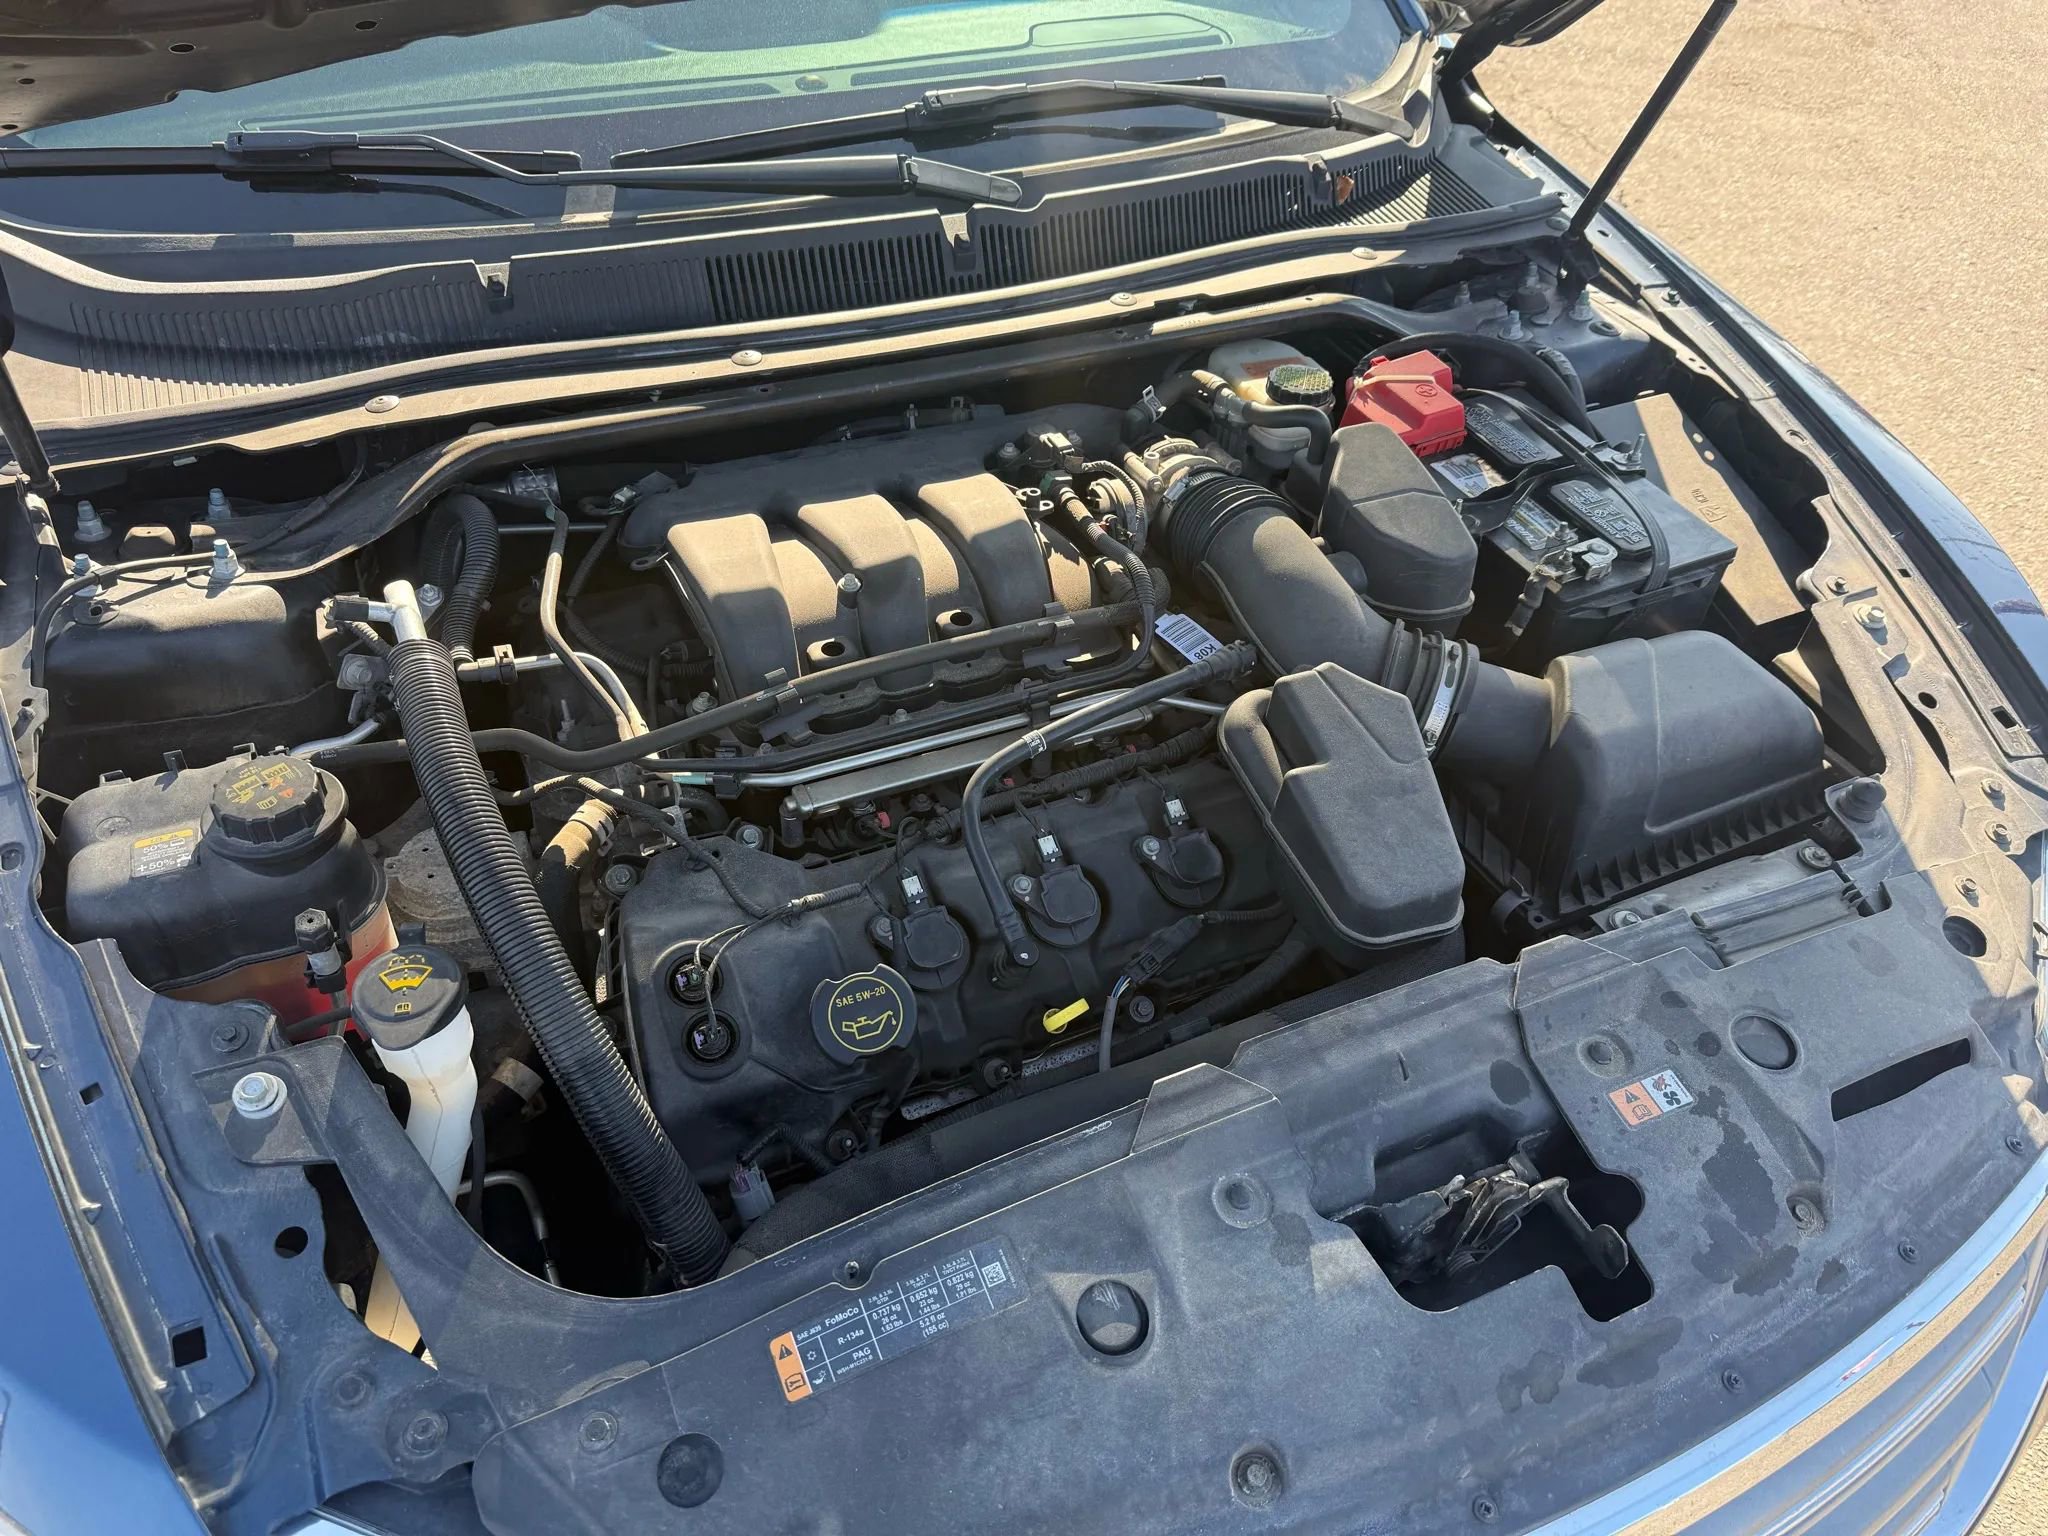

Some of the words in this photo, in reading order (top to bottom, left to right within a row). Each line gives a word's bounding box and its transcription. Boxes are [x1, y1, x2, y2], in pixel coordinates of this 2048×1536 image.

[1194, 644, 1217, 660] K08
[835, 995, 854, 1007] SAE
[856, 986, 886, 1001] 5W-20
[947, 1274, 964, 1286] 0.822
[910, 1290, 927, 1303] 0.652
[825, 1307, 859, 1326] FoMoCo
[872, 1306, 890, 1320] 0.737
[891, 1304, 901, 1312] kg
[920, 1318, 930, 1328] 5.2
[937, 1312, 946, 1320] oz
[796, 1330, 809, 1341] SAE
[837, 1329, 864, 1345] R-134a
[922, 1325, 937, 1338] (155
[938, 1320, 949, 1330] cc)
[852, 1347, 871, 1360] PAG
